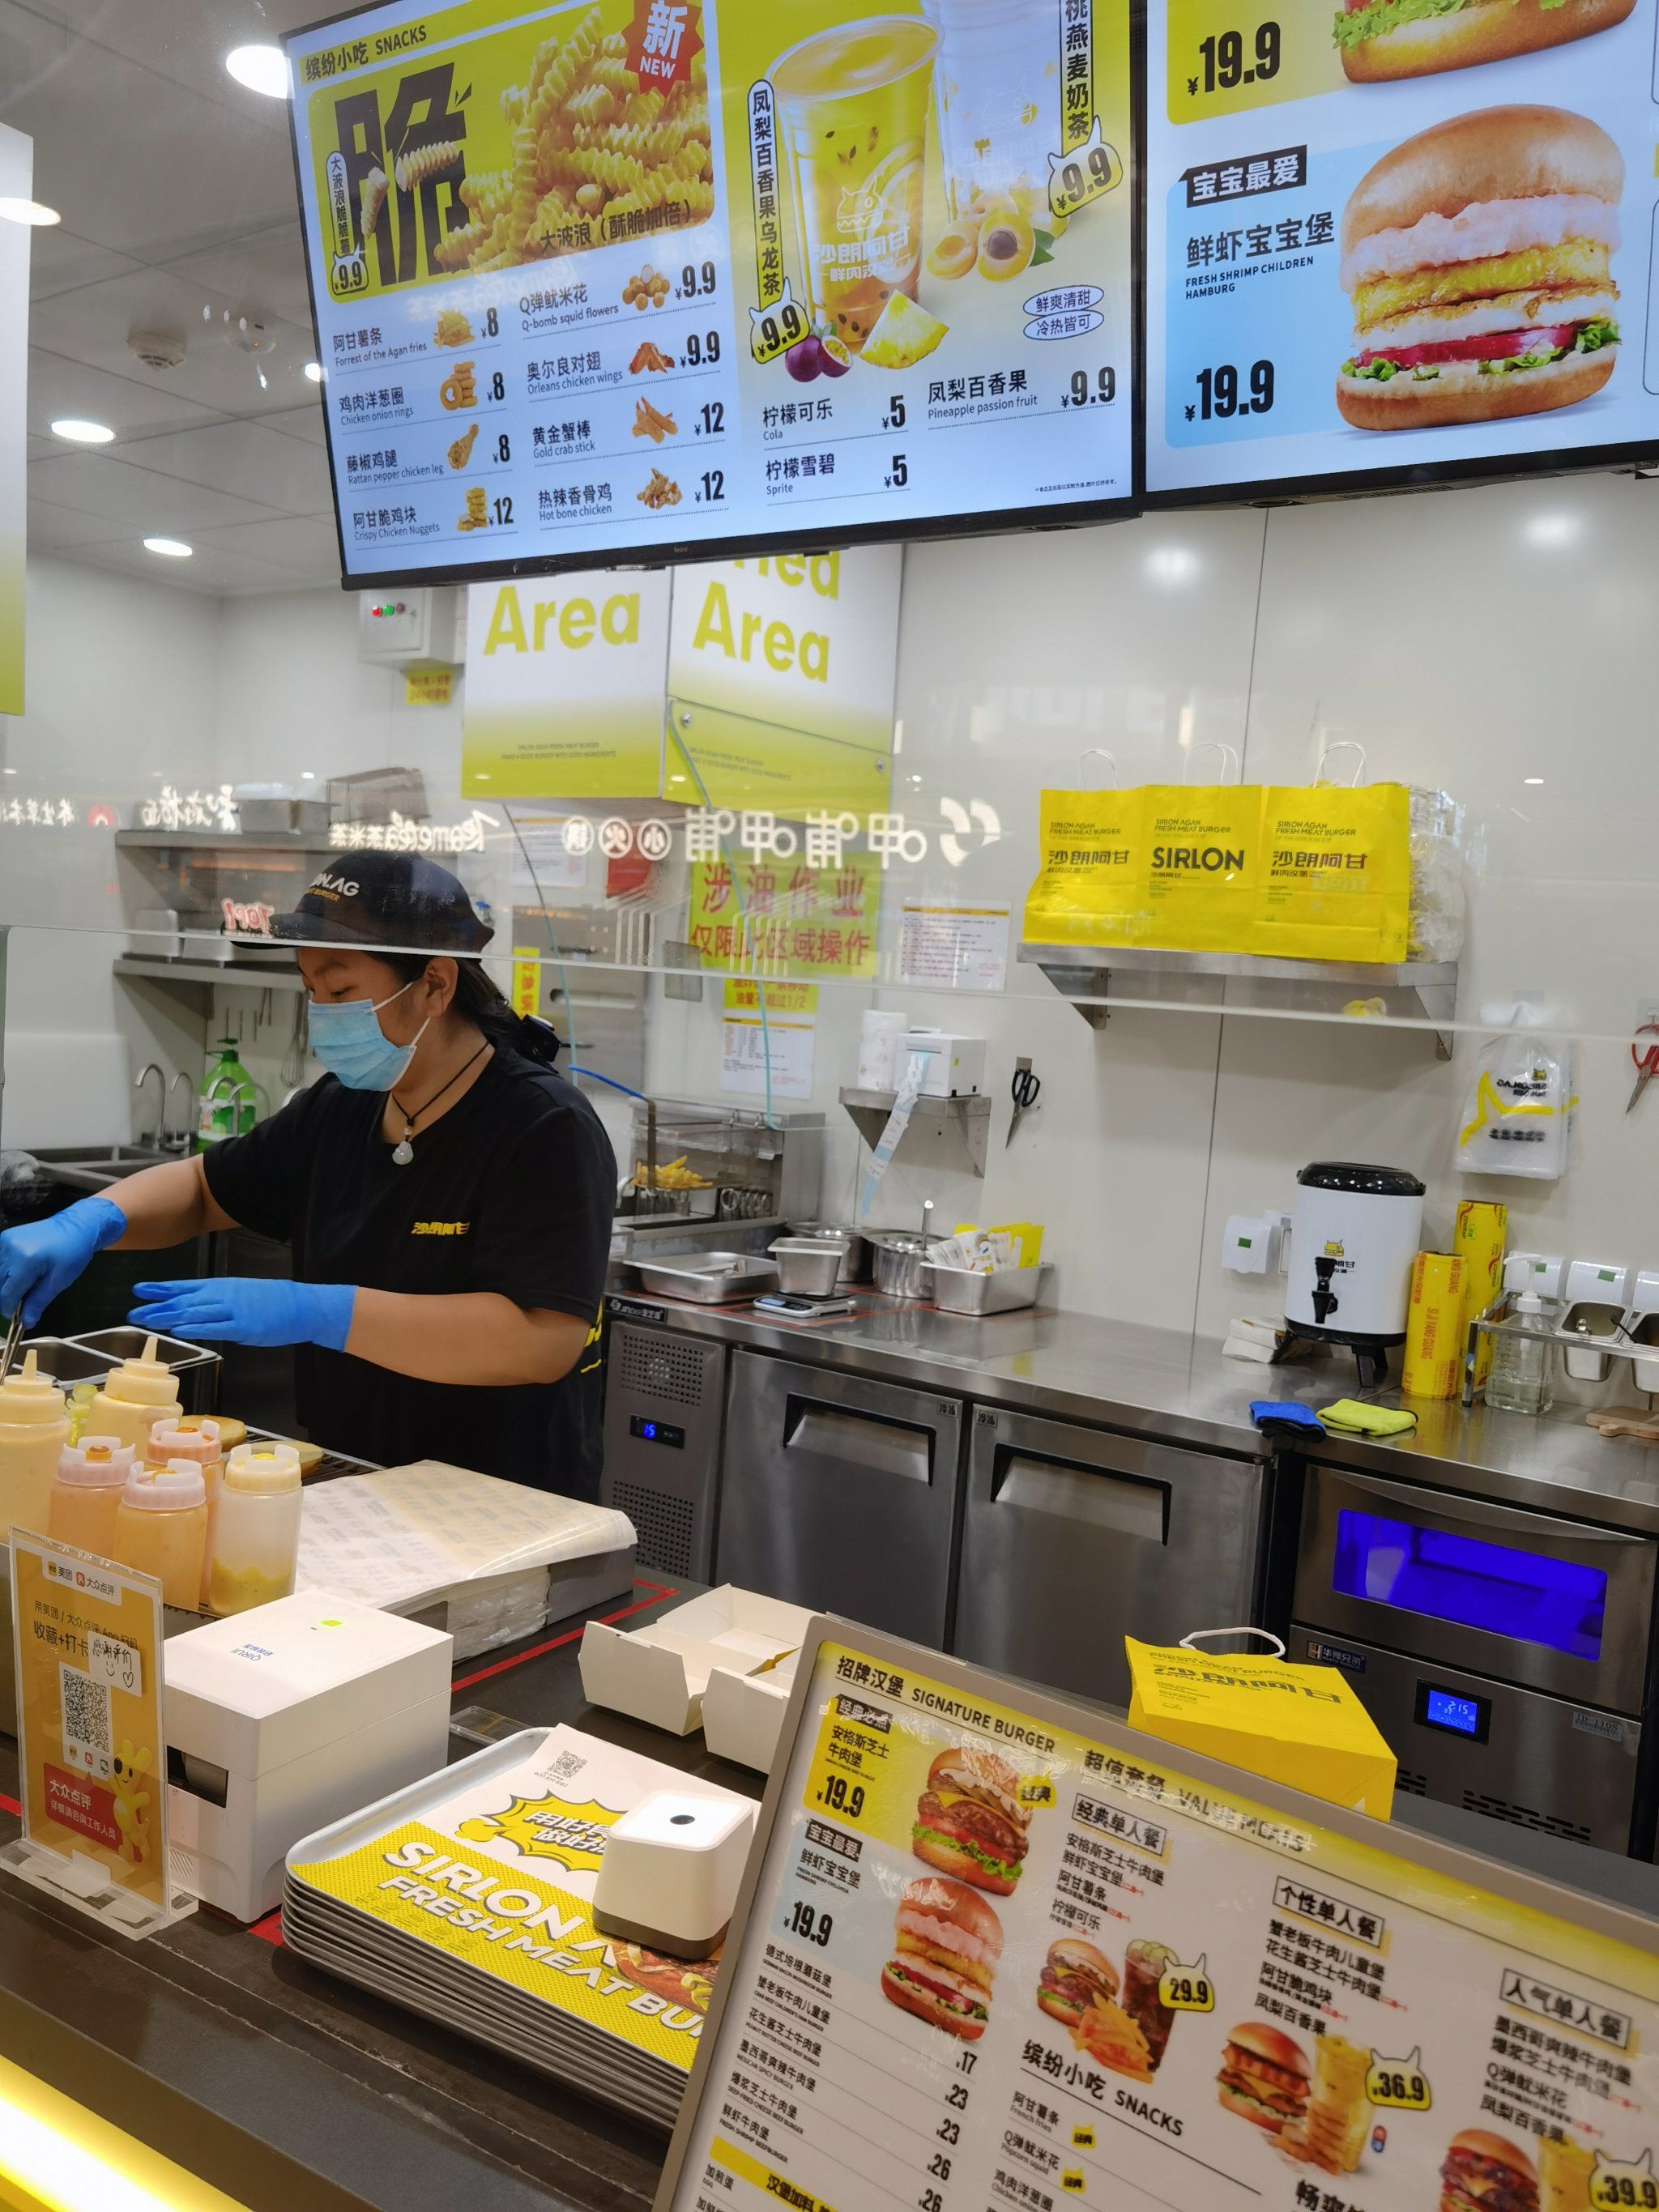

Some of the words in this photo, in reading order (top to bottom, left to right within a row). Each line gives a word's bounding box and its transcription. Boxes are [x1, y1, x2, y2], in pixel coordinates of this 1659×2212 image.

[643, 1, 686, 59] 新
[305, 41, 369, 81] 缤纷小吃
[376, 25, 427, 56] SNACKS
[640, 57, 676, 79] NEW
[1188, 22, 1281, 96] ¥19.9
[753, 90, 781, 296] 凤梨百香果乌龙茶
[1055, 146, 1113, 211] ¥9.9
[1192, 155, 1299, 201] 宝宝最爱
[1186, 211, 1334, 269] 鲜虾宝宝堡
[335, 261, 362, 292] ¥9.9
[675, 262, 716, 299] ¥9.9
[1186, 273, 1218, 288] FRESH
[1219, 266, 1259, 282] SHRIMP
[1261, 257, 1314, 274] CHILDREN
[1036, 288, 1091, 313] 鲜爽清甜
[1186, 282, 1235, 300] HAMBURG
[481, 307, 498, 339] ¥8
[522, 314, 558, 331] Q-bomb
[559, 309, 583, 325] squid
[585, 304, 619, 320] flowers
[756, 304, 802, 358] ¥9.9
[1036, 313, 1092, 337] 冷热皆可
[333, 328, 382, 352] 阿甘薯条
[335, 354, 361, 366] Forrest
[372, 349, 386, 360] the
[387, 347, 407, 360] Agan
[407, 342, 427, 355] fries
[680, 330, 721, 368] ¥9.9
[527, 351, 601, 383] 奥尔良对翅
[528, 380, 561, 395] Orleans
[561, 373, 595, 389] chicken
[597, 369, 623, 386] wings
[339, 386, 404, 414] 鸡肉洋葱圈
[487, 372, 505, 403] ¥8
[928, 369, 1027, 404] 凤梨百香果
[1062, 366, 1115, 407] ¥9.9
[1185, 360, 1274, 421] ¥19.9
[341, 412, 370, 426] Chicken
[372, 410, 392, 421] onion
[393, 406, 414, 420] rings
[694, 403, 724, 435] ¥12
[762, 399, 834, 428] 柠檬可乐
[882, 394, 906, 429] ¥5
[928, 403, 975, 420] Pineapple
[977, 398, 1013, 416] passion
[1016, 394, 1038, 408] fruit
[493, 434, 511, 464] ¥8
[532, 420, 591, 445] 黄金蟹棒
[533, 445, 552, 459] Gold
[555, 442, 574, 456] crab
[575, 440, 596, 454] stick
[763, 429, 783, 441] Cola
[346, 451, 398, 474] 藤椒鸡腿
[348, 473, 372, 485] Rattan
[373, 471, 400, 485] pepper
[402, 466, 429, 479] chicken
[431, 463, 444, 477] leg
[766, 454, 834, 481] 柠檬雪碧
[885, 454, 908, 488] ¥5
[538, 484, 612, 509] 热辣香骨鸡
[694, 471, 724, 503] ¥12
[766, 482, 794, 495] Sprite
[352, 508, 417, 529] 阿甘脆鸡块
[488, 497, 514, 526] ¥12
[539, 509, 555, 522] Hot
[557, 507, 578, 520] bone
[579, 504, 612, 518] chicken
[355, 529, 377, 542] Crispy
[378, 526, 407, 538] Chicken
[409, 522, 440, 537] Nuggets
[484, 586, 640, 655] Area
[692, 582, 830, 683] Area
[1048, 850, 1130, 865] 沙朗阿甘
[1151, 846, 1244, 872] SIRLON
[1272, 850, 1367, 869] 沙朗阿甘
[1424, 1320, 1436, 1339] YANG
[1421, 1339, 1435, 1360] GUANG
[58, 1566, 72, 1581] 美团
[87, 1577, 114, 1596] 大众点评
[837, 1656, 904, 1698] 招牌汉堡
[911, 1687, 991, 1729] SIGNATURE
[994, 1719, 1056, 1754] BURGER
[828, 1743, 863, 1768] 牛肉堡
[832, 1725, 889, 1759] 安格斯芝士
[50, 1779, 92, 1810] 大众点评
[817, 1775, 865, 1818] ¥19.9
[50, 1800, 117, 1841] 详情请咨询工作人员
[1077, 1801, 1160, 1850] 经典单人餐
[808, 1822, 859, 1858] 宝宝最爱
[800, 1848, 861, 1889] 鲜虾宝宝堡
[1062, 1850, 1124, 1888] 鲜虾宝宝堡
[1067, 1833, 1164, 1886] 安格斯芝士牛肉堡
[383, 1841, 586, 1941] SIRLON
[1058, 1869, 1107, 1902] 阿甘薯条
[783, 1900, 833, 1947] ¥19.9
[1052, 1899, 1102, 1931] 柠檬可乐
[1280, 1885, 1376, 1941] 个性单人餐
[377, 1876, 520, 1942] FRESH
[502, 1933, 635, 1997] MEAT
[1269, 1919, 1385, 1982] 蟹老板牛肉儿童堡
[766, 1943, 833, 1988] 德式培根蘑菇堡
[1260, 1960, 1333, 2005] 阿甘脆鸡块
[1265, 1938, 1382, 2002] 花生酱芝士牛肉堡
[757, 1974, 830, 2024] 蟹老板牛肉儿童堡
[1254, 1992, 1326, 2036] 凤梨百香果
[1506, 1977, 1623, 2041] 人气单人餐
[748, 2007, 822, 2057] 花生酱芝士牛肉堡
[740, 2039, 817, 2093] 墨西哥爽辣牛肉堡
[1495, 2014, 1632, 2086] 墨西哥爽辣牛肉堡
[1491, 2035, 1611, 2100] 爆浆芝士牛肉堡
[730, 2071, 798, 2120] 爆浆芝士牛肉堡
[1021, 2039, 1107, 2101] 缤纷小吃
[1114, 2089, 1183, 2136] SNACKS
[722, 2103, 770, 2142] 鲜虾牛肉堡
[1013, 2091, 1060, 2126] 阿甘薯条
[1480, 2093, 1568, 2147] 凤梨百香果
